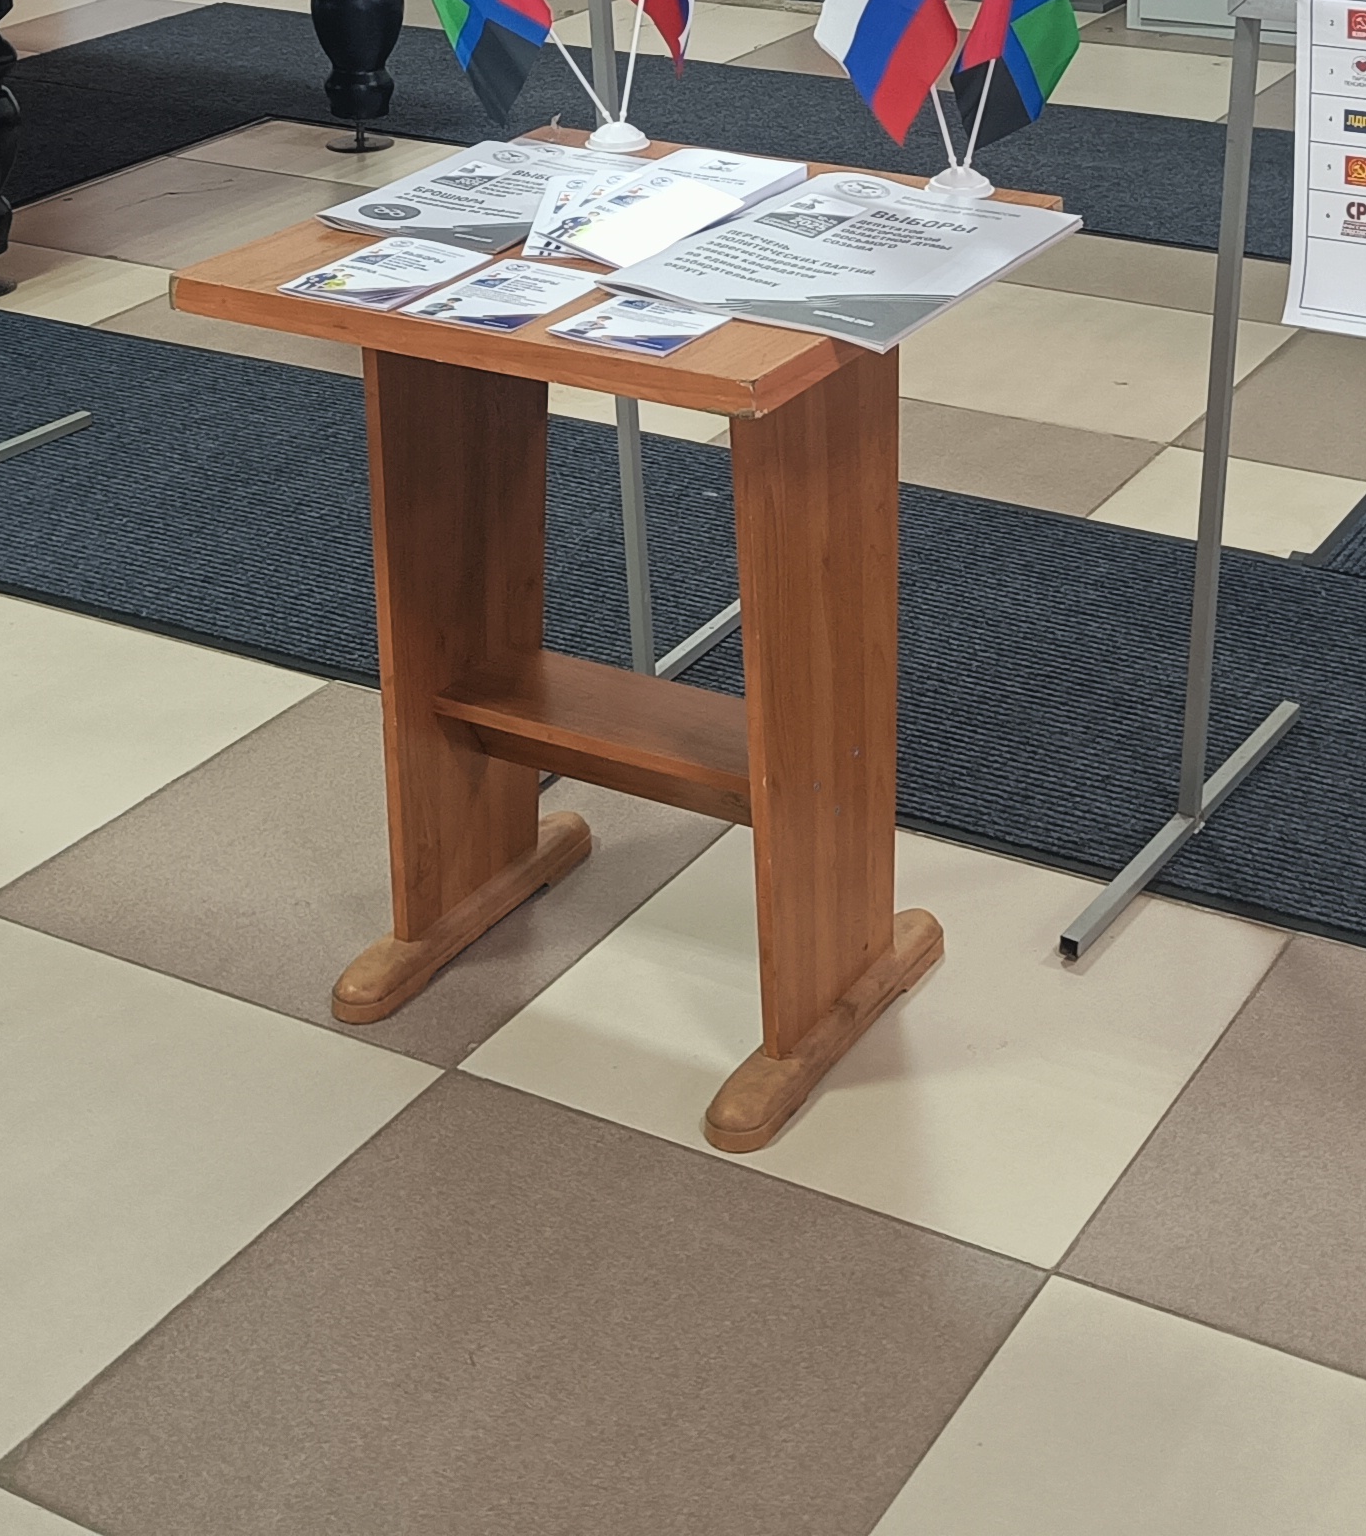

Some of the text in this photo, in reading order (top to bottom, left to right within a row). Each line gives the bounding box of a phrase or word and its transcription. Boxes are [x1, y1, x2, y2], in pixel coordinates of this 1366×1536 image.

[413, 186, 485, 205] БРОШЮРА
[869, 210, 980, 235] ВЫБОРЫ
[725, 229, 790, 251] ПЕРЕЧЕНЬ
